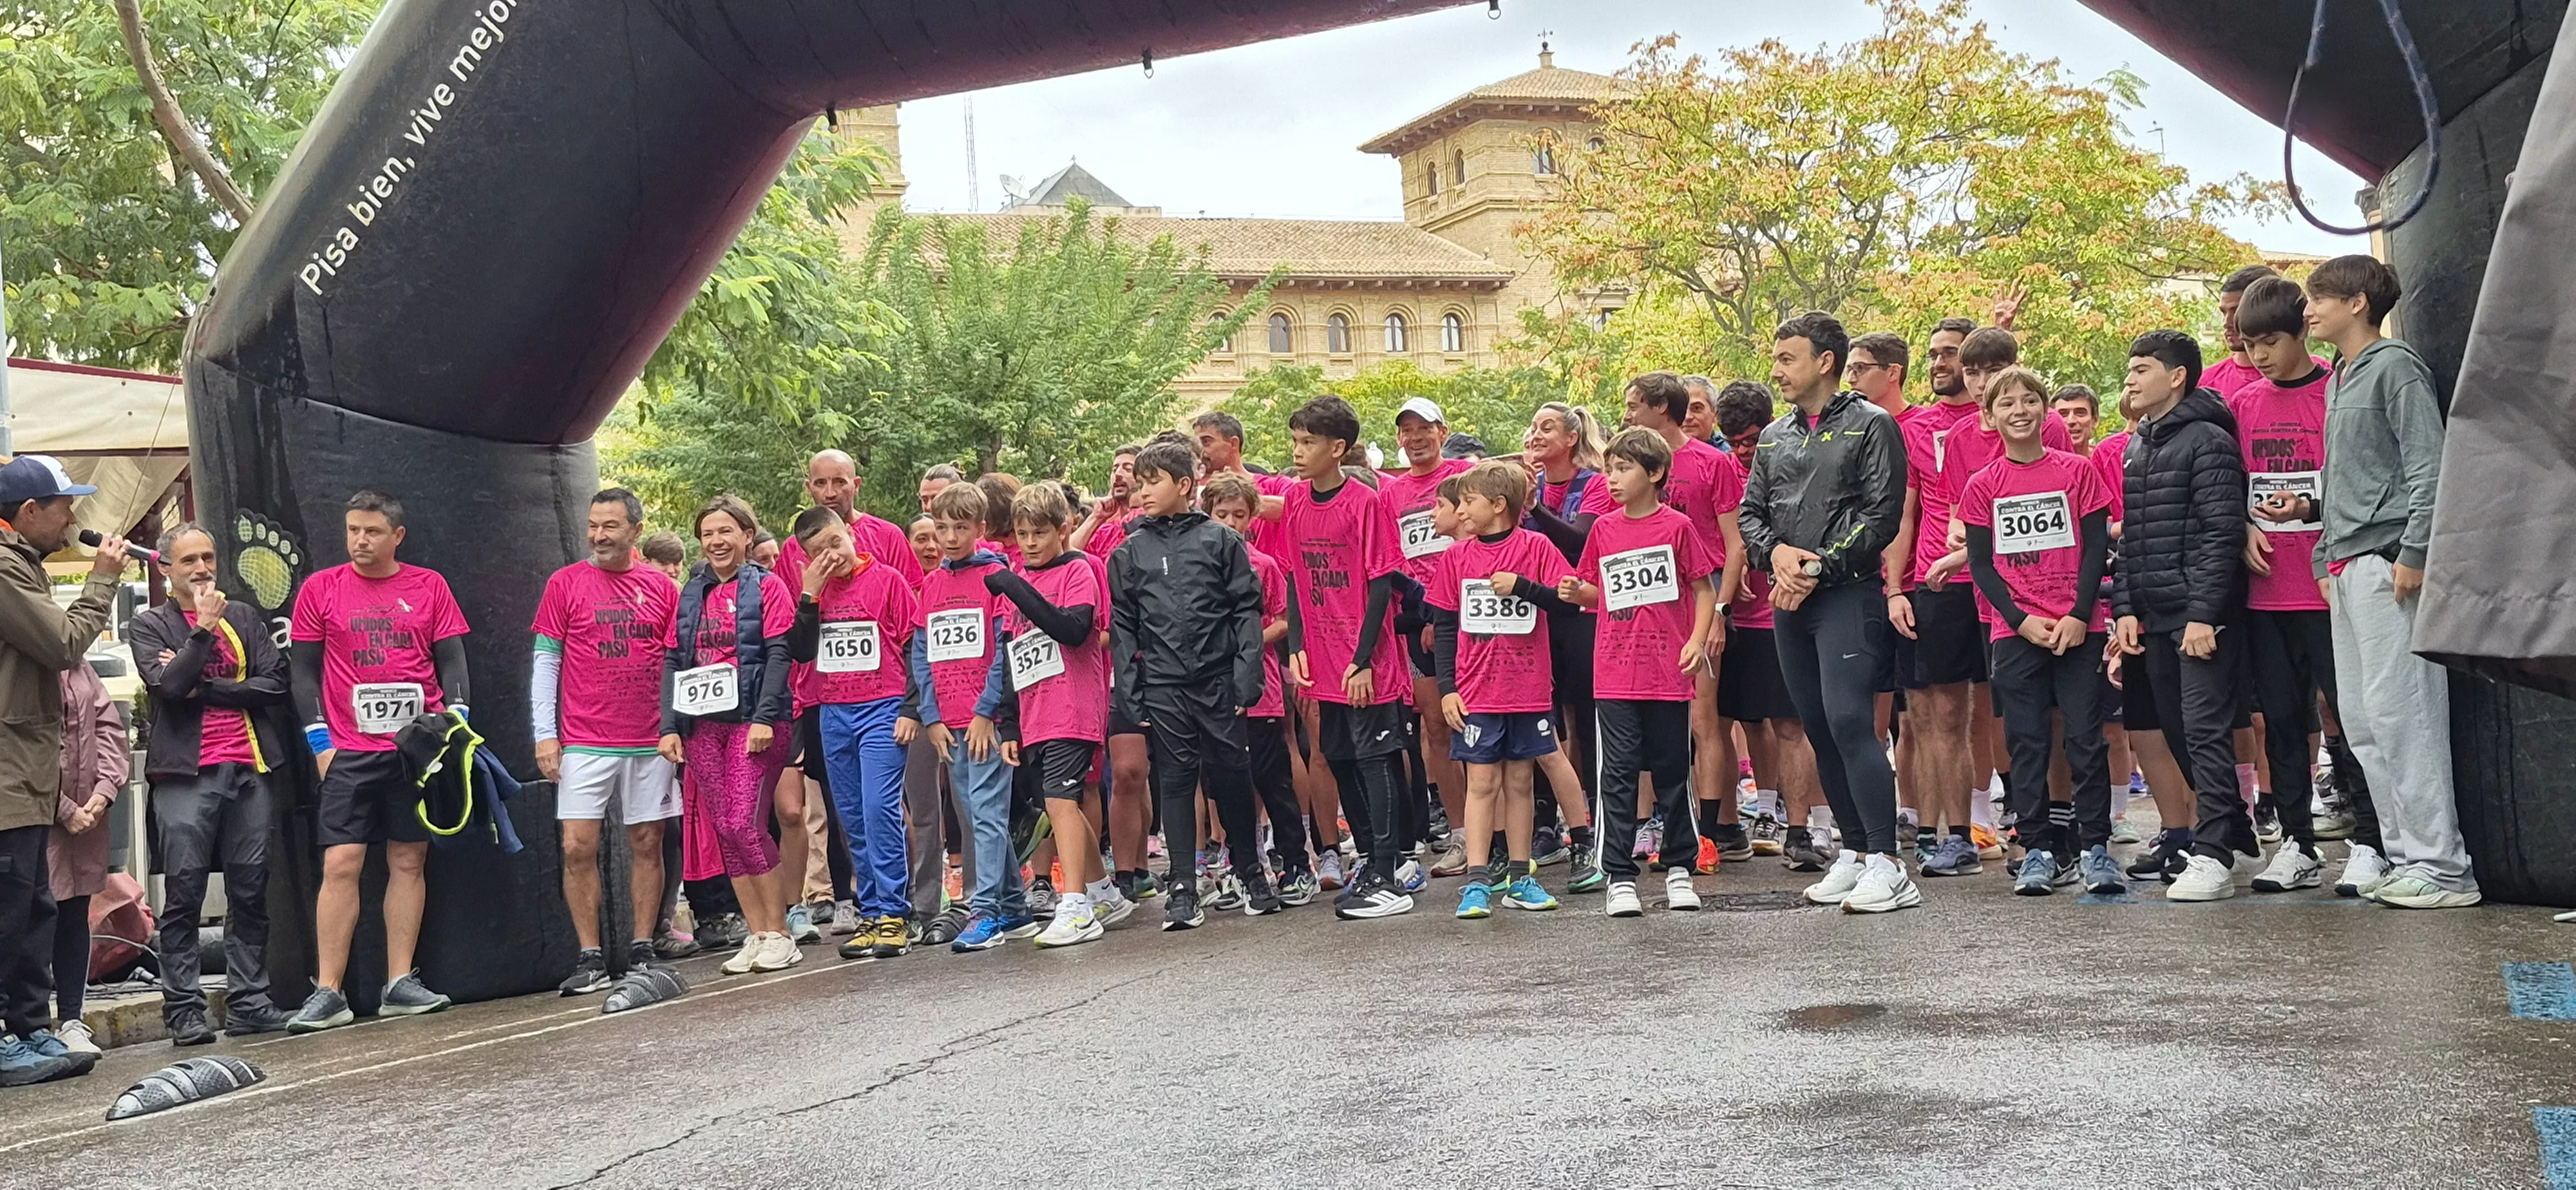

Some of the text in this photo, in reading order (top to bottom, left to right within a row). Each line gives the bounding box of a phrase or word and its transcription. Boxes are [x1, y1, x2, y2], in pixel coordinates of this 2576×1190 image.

[299, 227, 359, 296] Pisa
[347, 156, 415, 227] bien,
[404, 83, 455, 146] vive
[2002, 510, 2065, 537] 3064
[1610, 565, 1669, 594] 3304
[1469, 598, 1529, 618] 3386
[933, 625, 977, 646] 1236
[825, 638, 872, 657] 1650
[1016, 641, 1054, 674] 3527
[688, 680, 724, 703] 976
[361, 700, 415, 719] 1971
